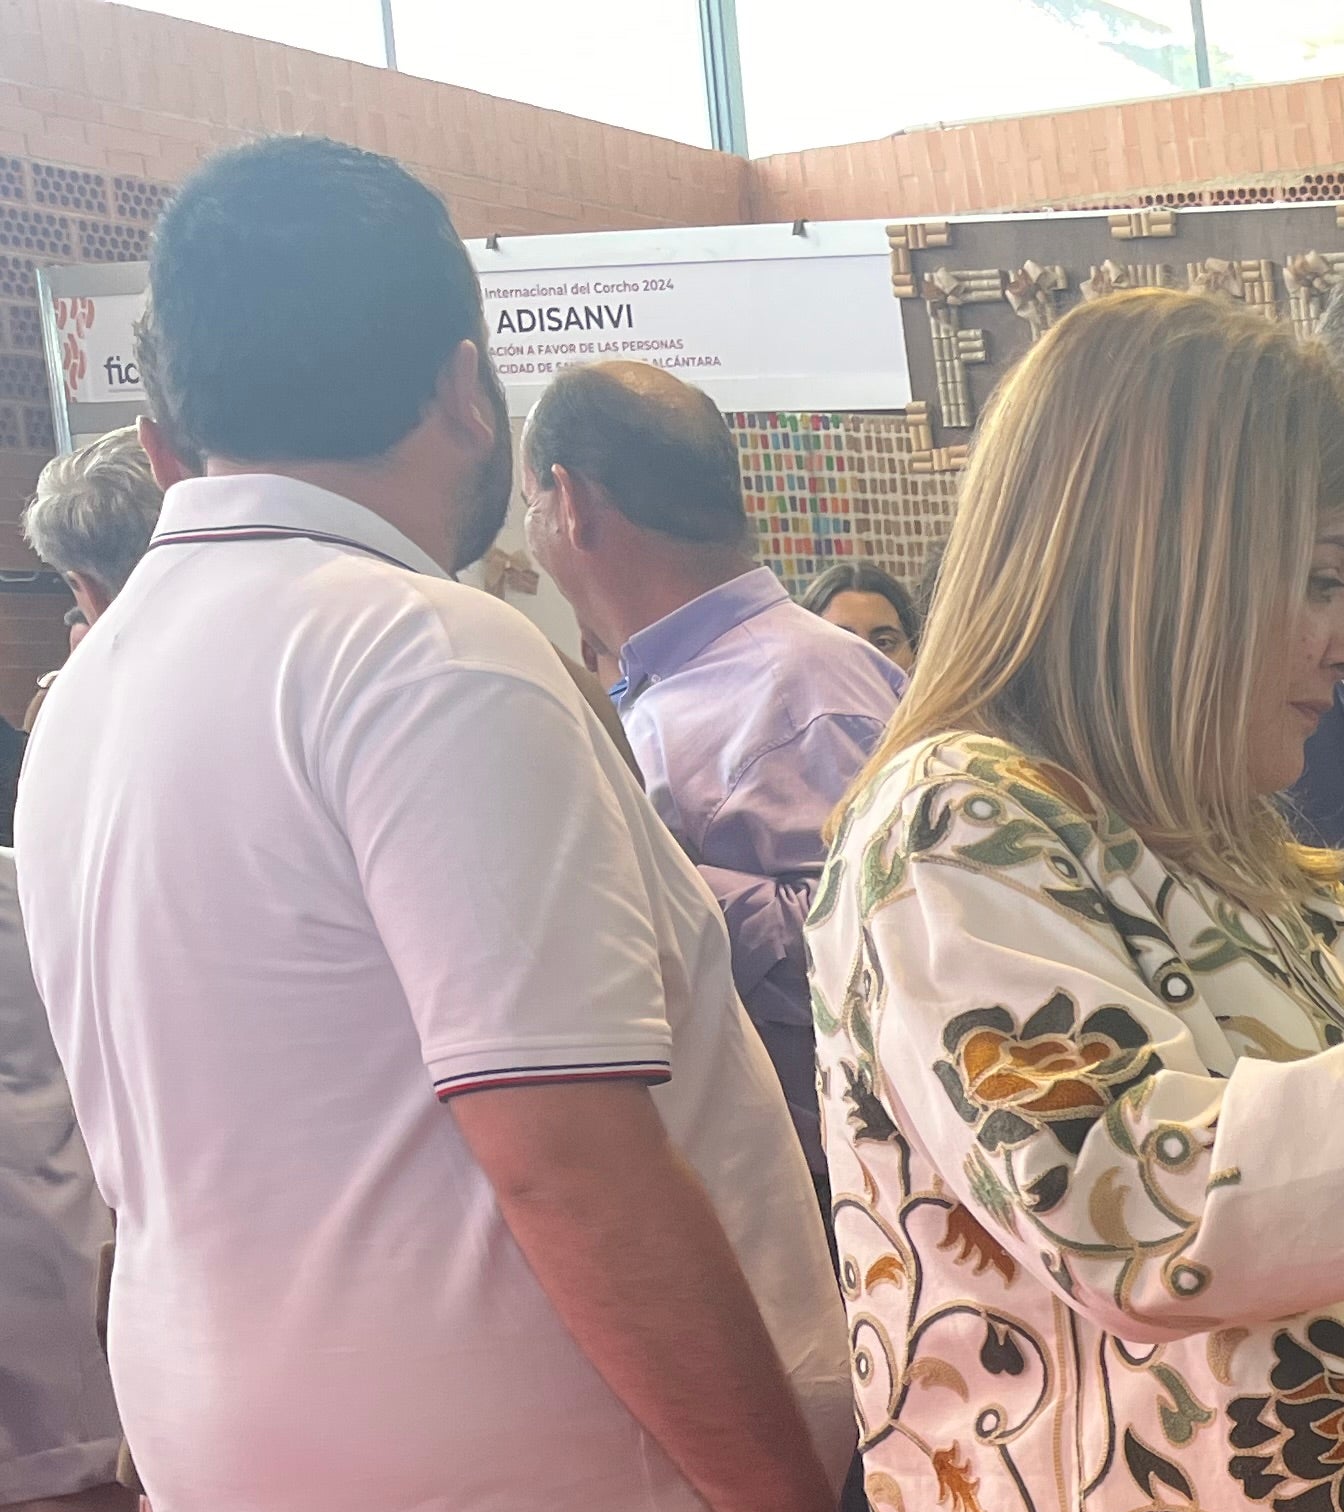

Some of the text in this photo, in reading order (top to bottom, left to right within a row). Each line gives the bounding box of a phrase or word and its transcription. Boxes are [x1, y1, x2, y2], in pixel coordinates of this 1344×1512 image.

[485, 279, 674, 299] Internacional del Corcho 2024
[497, 304, 634, 334] ADISANVI
[527, 339, 684, 355] A FAVOR DE LAS PERSONAS
